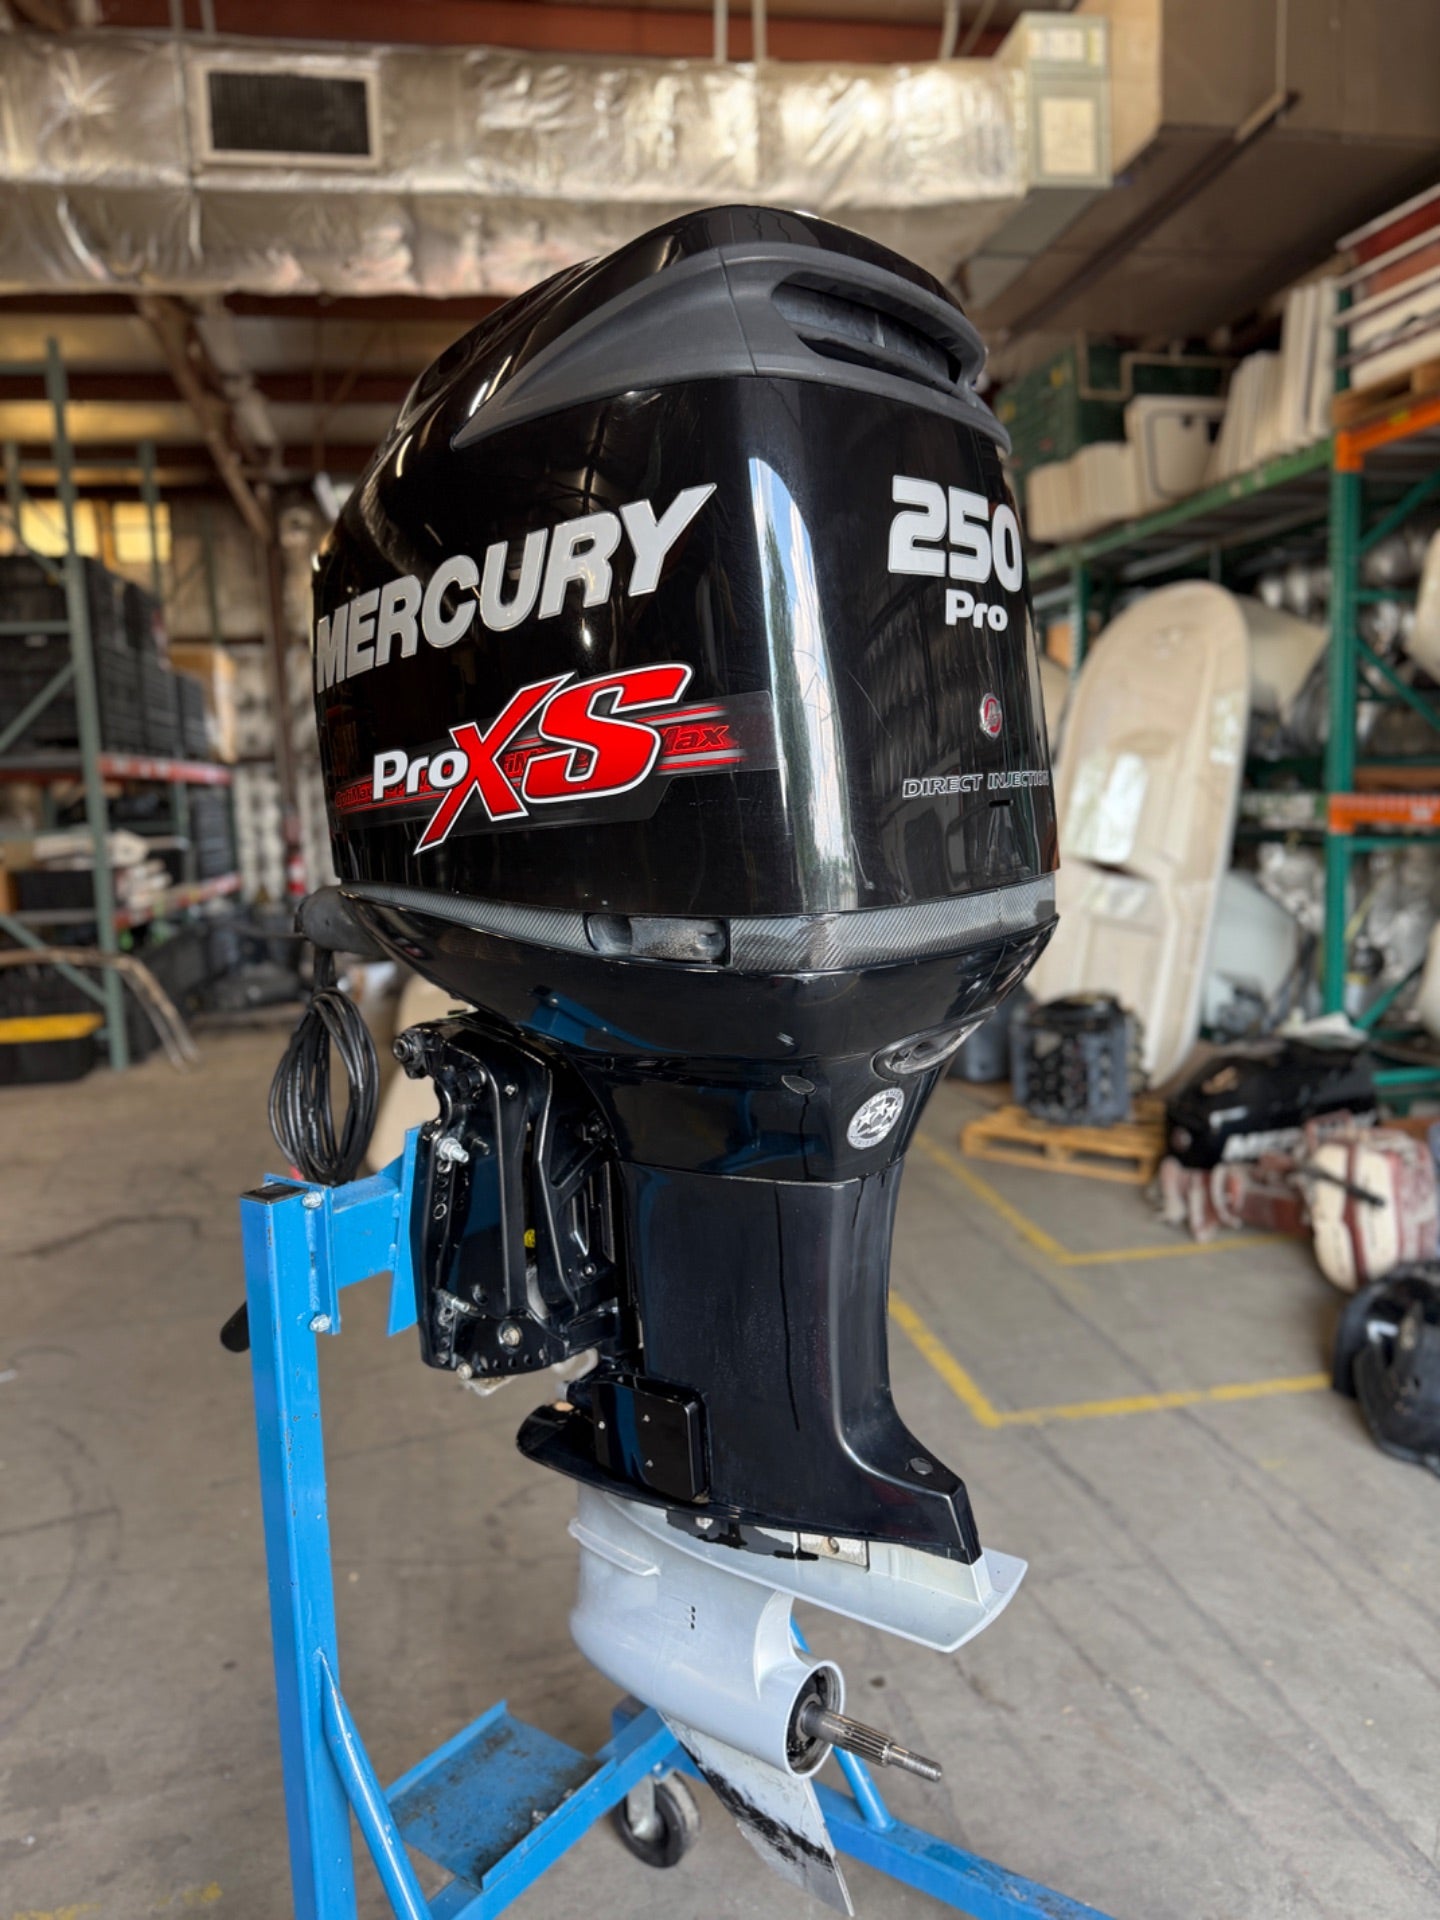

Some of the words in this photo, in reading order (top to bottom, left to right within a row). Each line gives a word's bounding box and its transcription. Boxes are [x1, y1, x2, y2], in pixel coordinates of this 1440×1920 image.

[888, 474, 1023, 592] 250
[316, 482, 718, 694] MERCURY
[945, 589, 1008, 632] Pro
[902, 774, 983, 799] DIRECT
